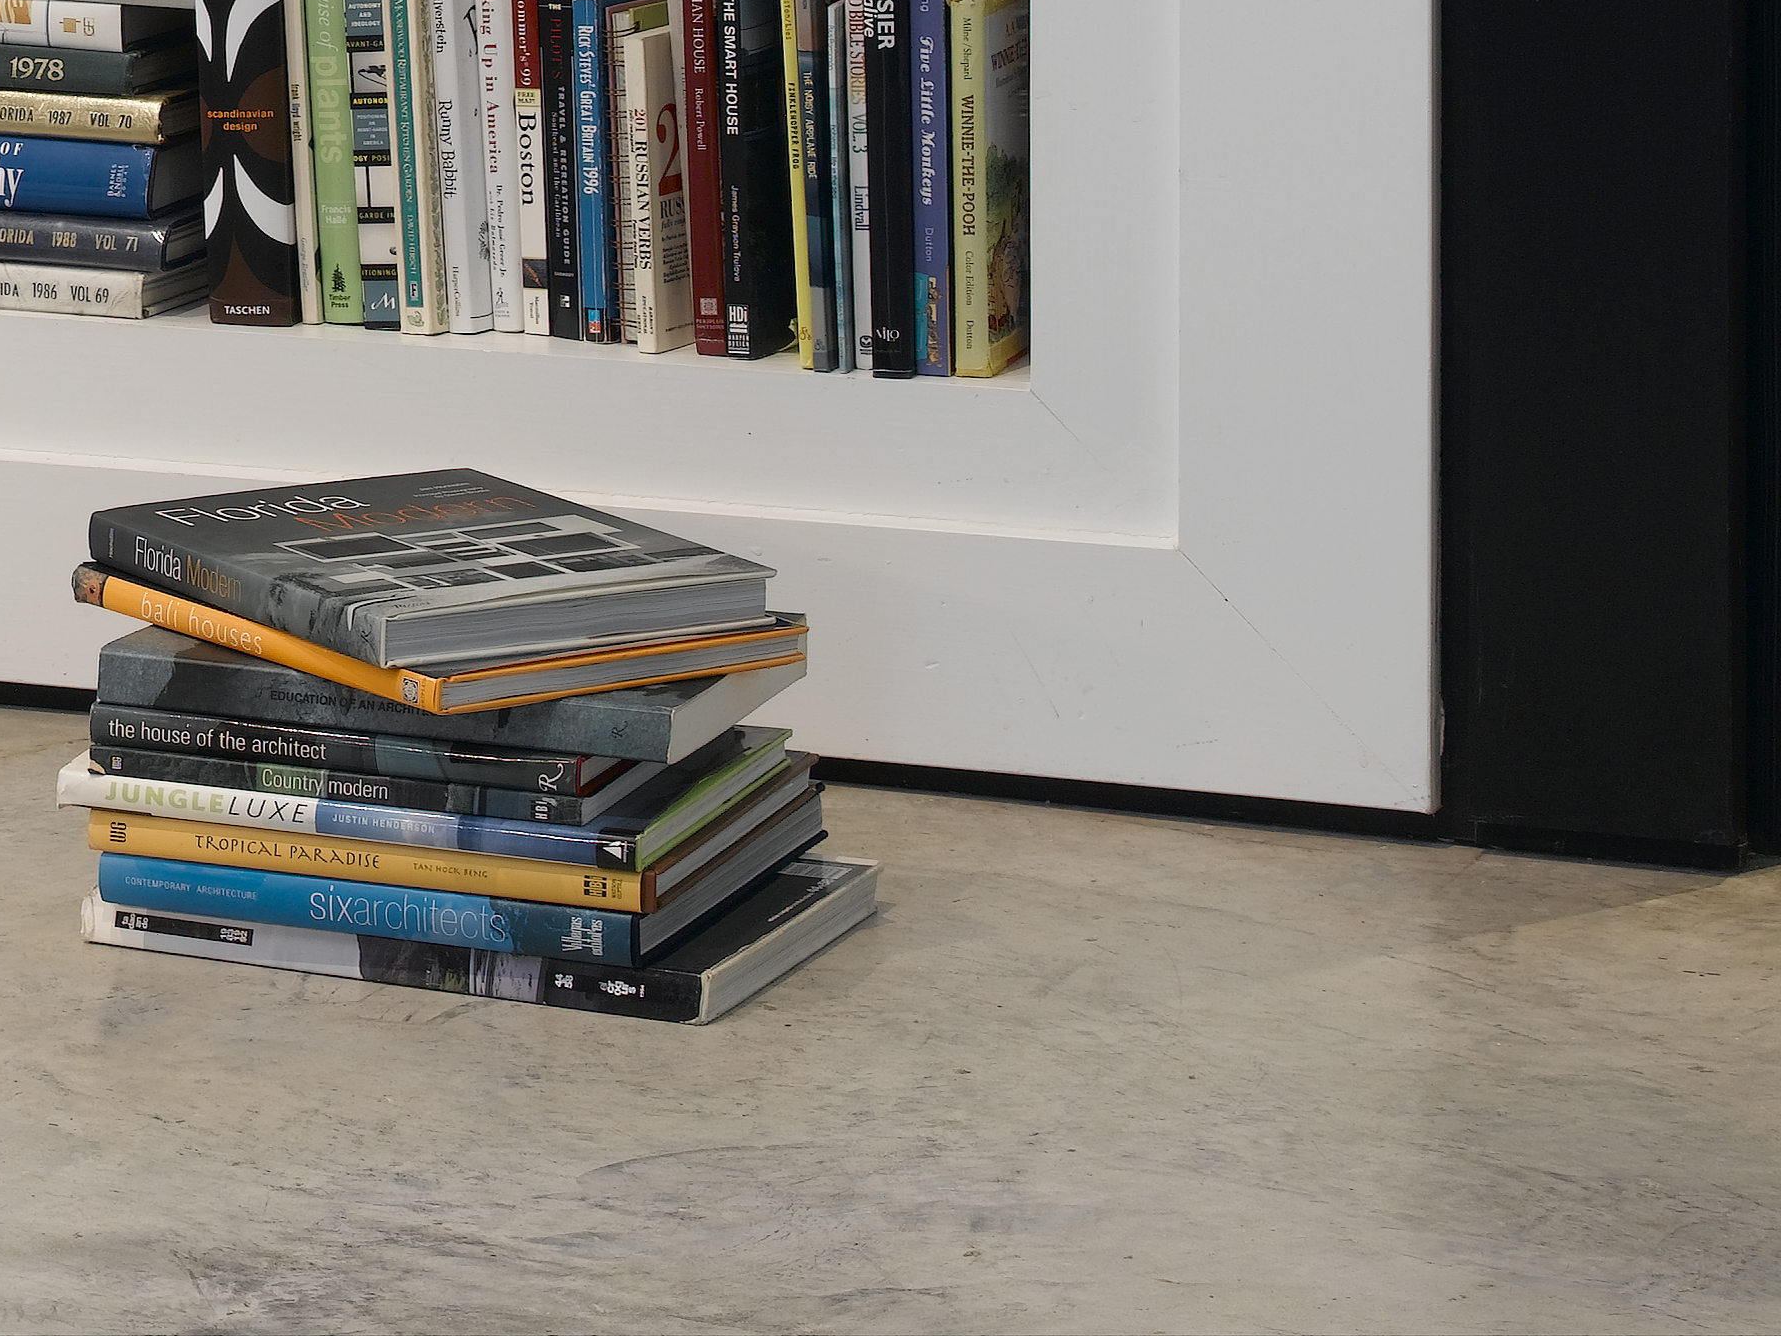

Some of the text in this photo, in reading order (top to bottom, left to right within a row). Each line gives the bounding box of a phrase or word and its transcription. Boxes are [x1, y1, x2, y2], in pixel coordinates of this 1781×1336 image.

[10, 56, 65, 82] 1978
[517, 110, 537, 206] Boston
[959, 93, 977, 237] WINNIE-THE-POOH
[133, 535, 242, 602] Florida Modern
[139, 590, 264, 655] bali houses
[107, 718, 327, 761] the house of the architect
[261, 769, 389, 801] Country modern
[194, 833, 381, 870] TROPICAL PARADISE
